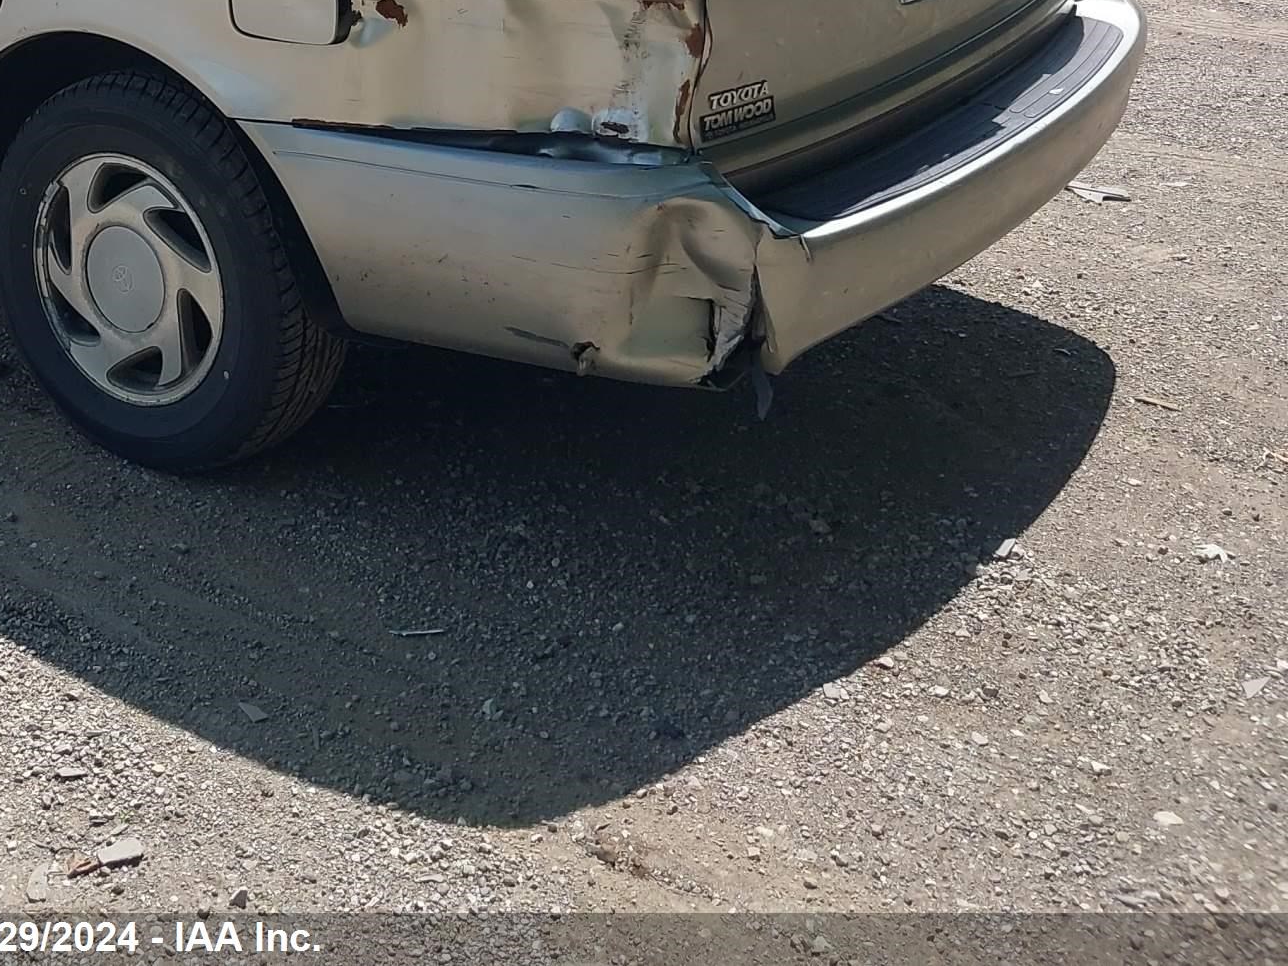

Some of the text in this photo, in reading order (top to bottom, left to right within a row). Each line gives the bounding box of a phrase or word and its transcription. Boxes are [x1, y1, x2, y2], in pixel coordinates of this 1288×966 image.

[709, 81, 770, 110] TOYOTA
[703, 109, 733, 132] TOM
[734, 98, 772, 123] WOOD
